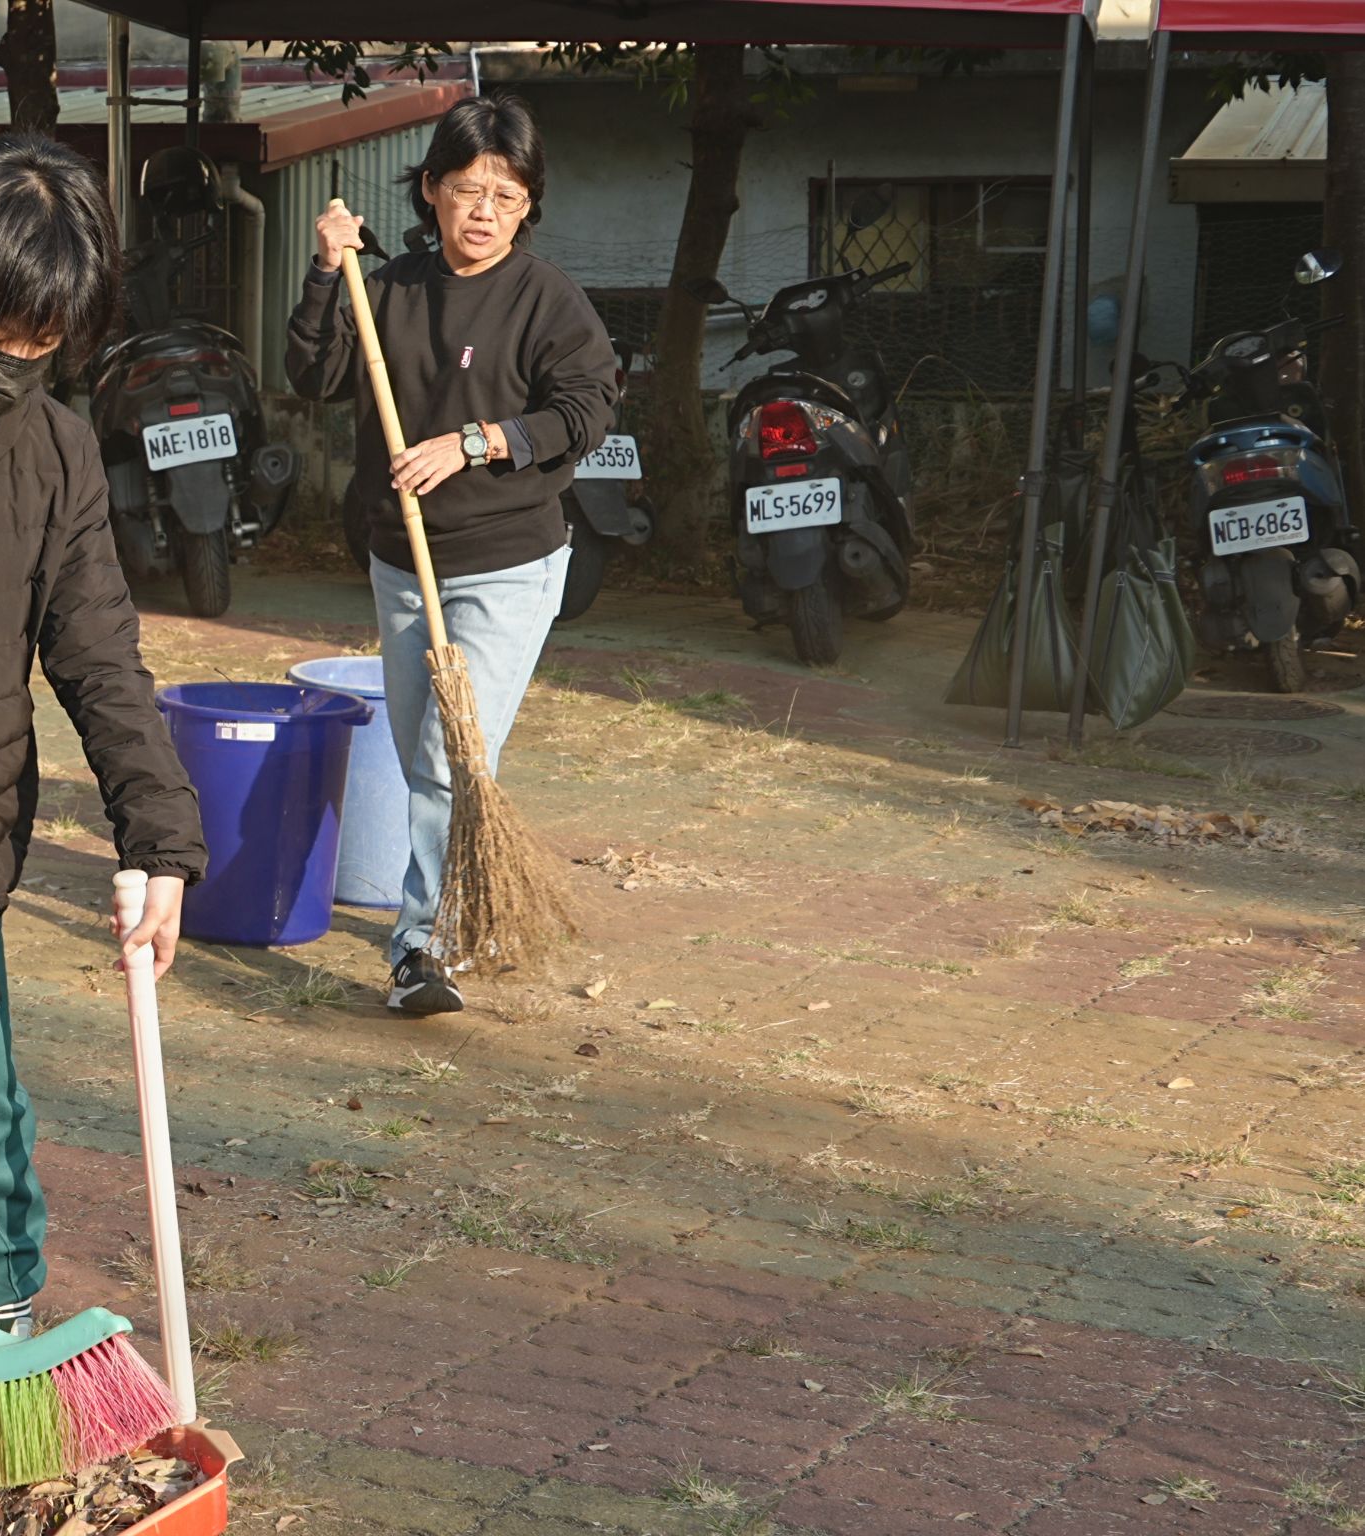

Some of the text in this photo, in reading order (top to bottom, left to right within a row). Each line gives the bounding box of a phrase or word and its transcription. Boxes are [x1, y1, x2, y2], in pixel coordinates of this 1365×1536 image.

[148, 425, 232, 459] NAE-1818
[750, 490, 836, 522] MLS-5699
[1213, 509, 1303, 545] NCB-6863
